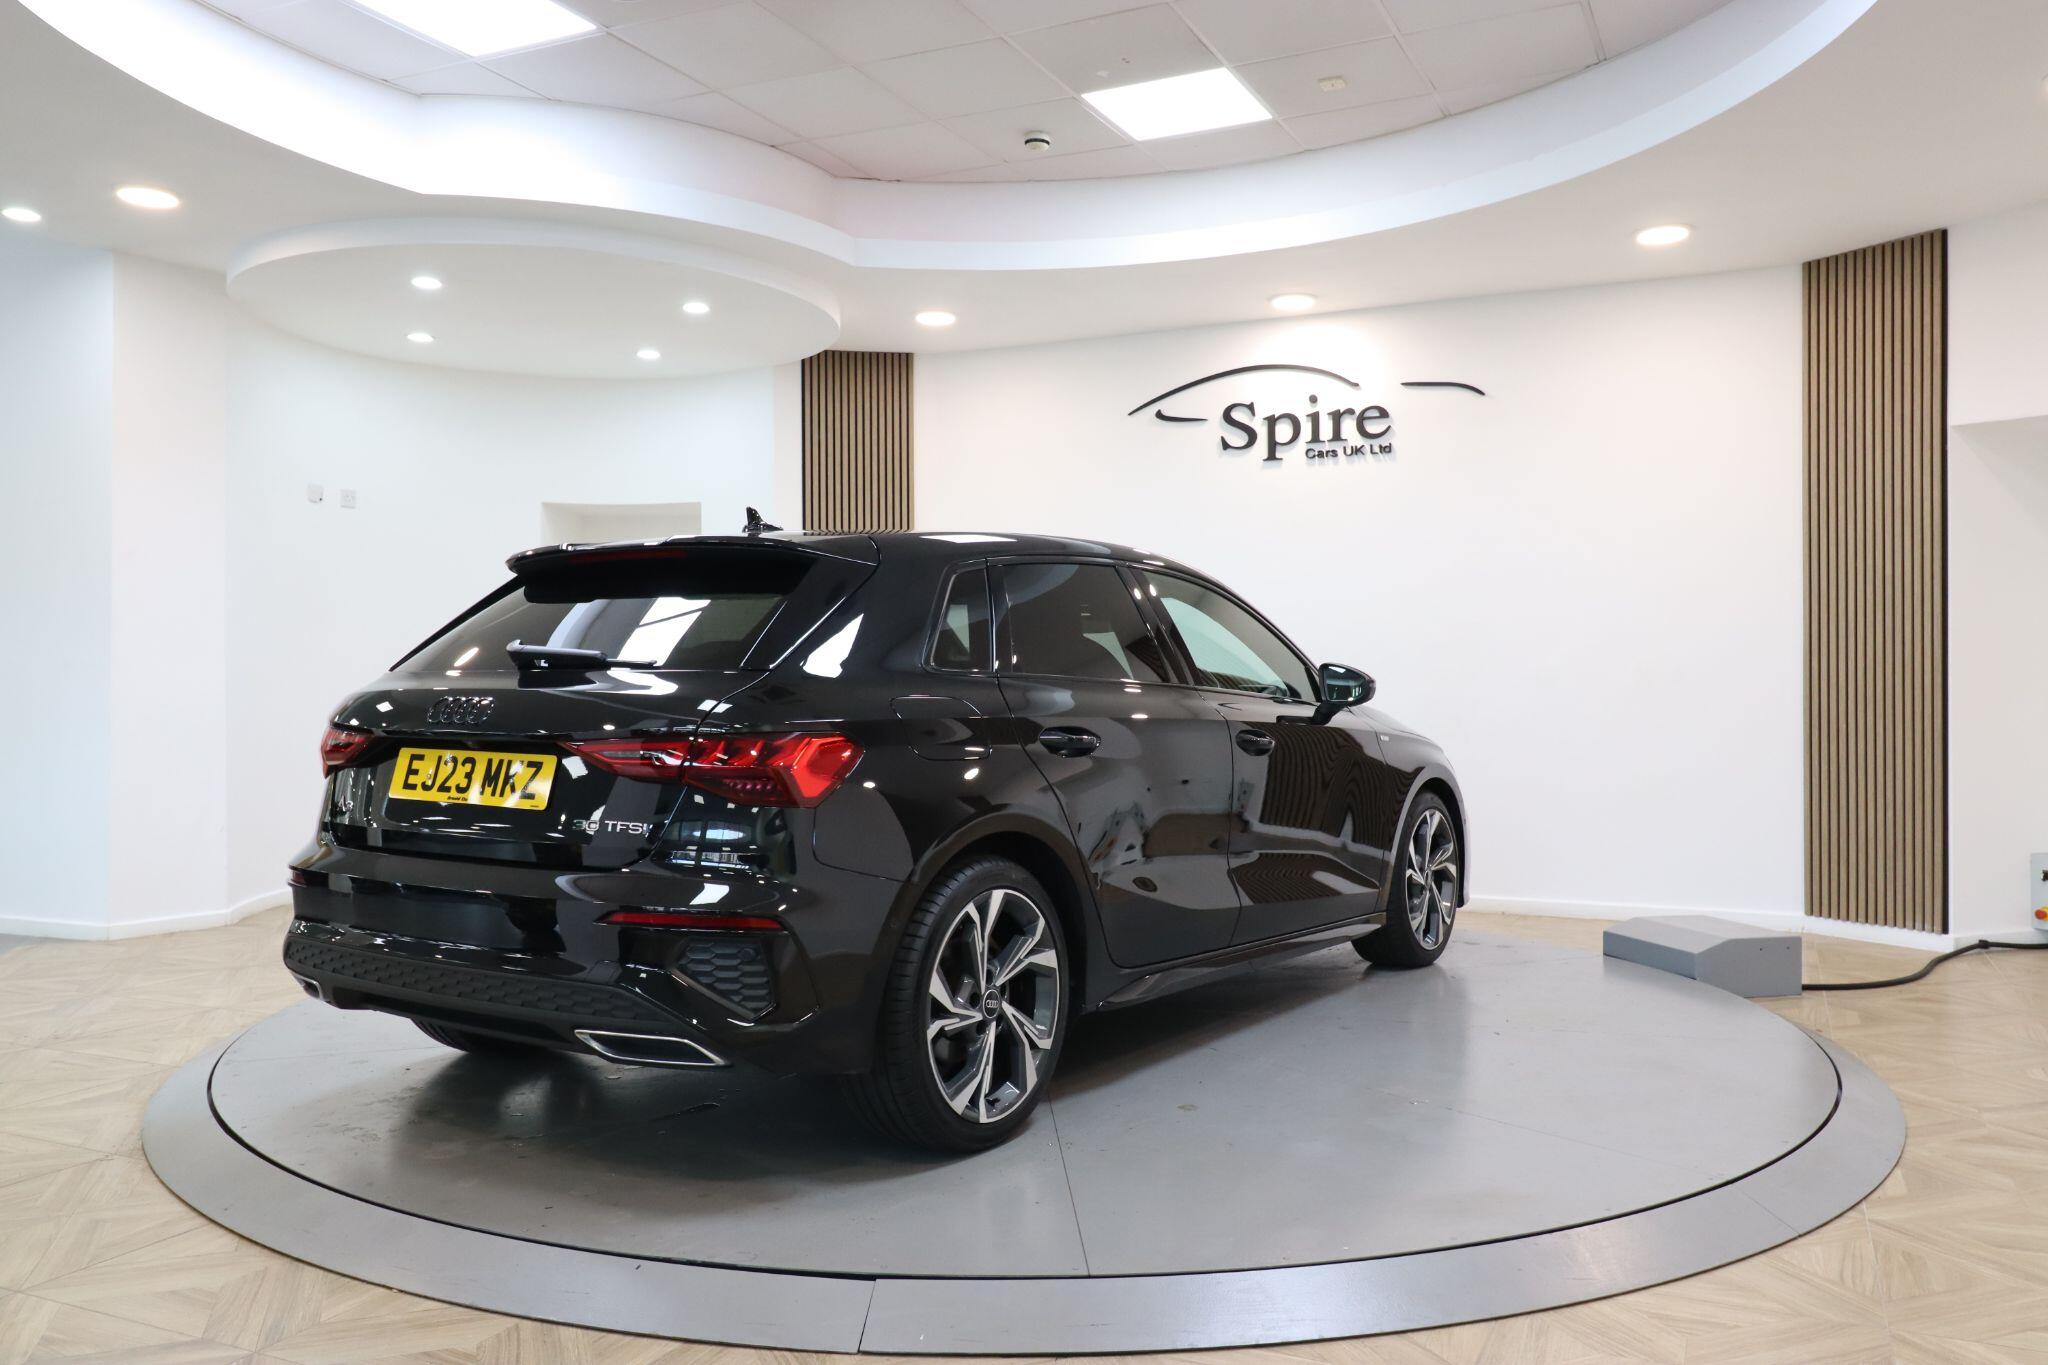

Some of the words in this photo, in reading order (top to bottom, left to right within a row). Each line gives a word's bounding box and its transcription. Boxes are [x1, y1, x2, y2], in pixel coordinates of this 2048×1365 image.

[1221, 394, 1391, 461] Spire
[1305, 447, 1338, 459] Cars
[1343, 444, 1365, 456] UK
[1370, 442, 1392, 455] Ltd
[402, 753, 477, 795] EJ23
[479, 757, 544, 801] MKZ
